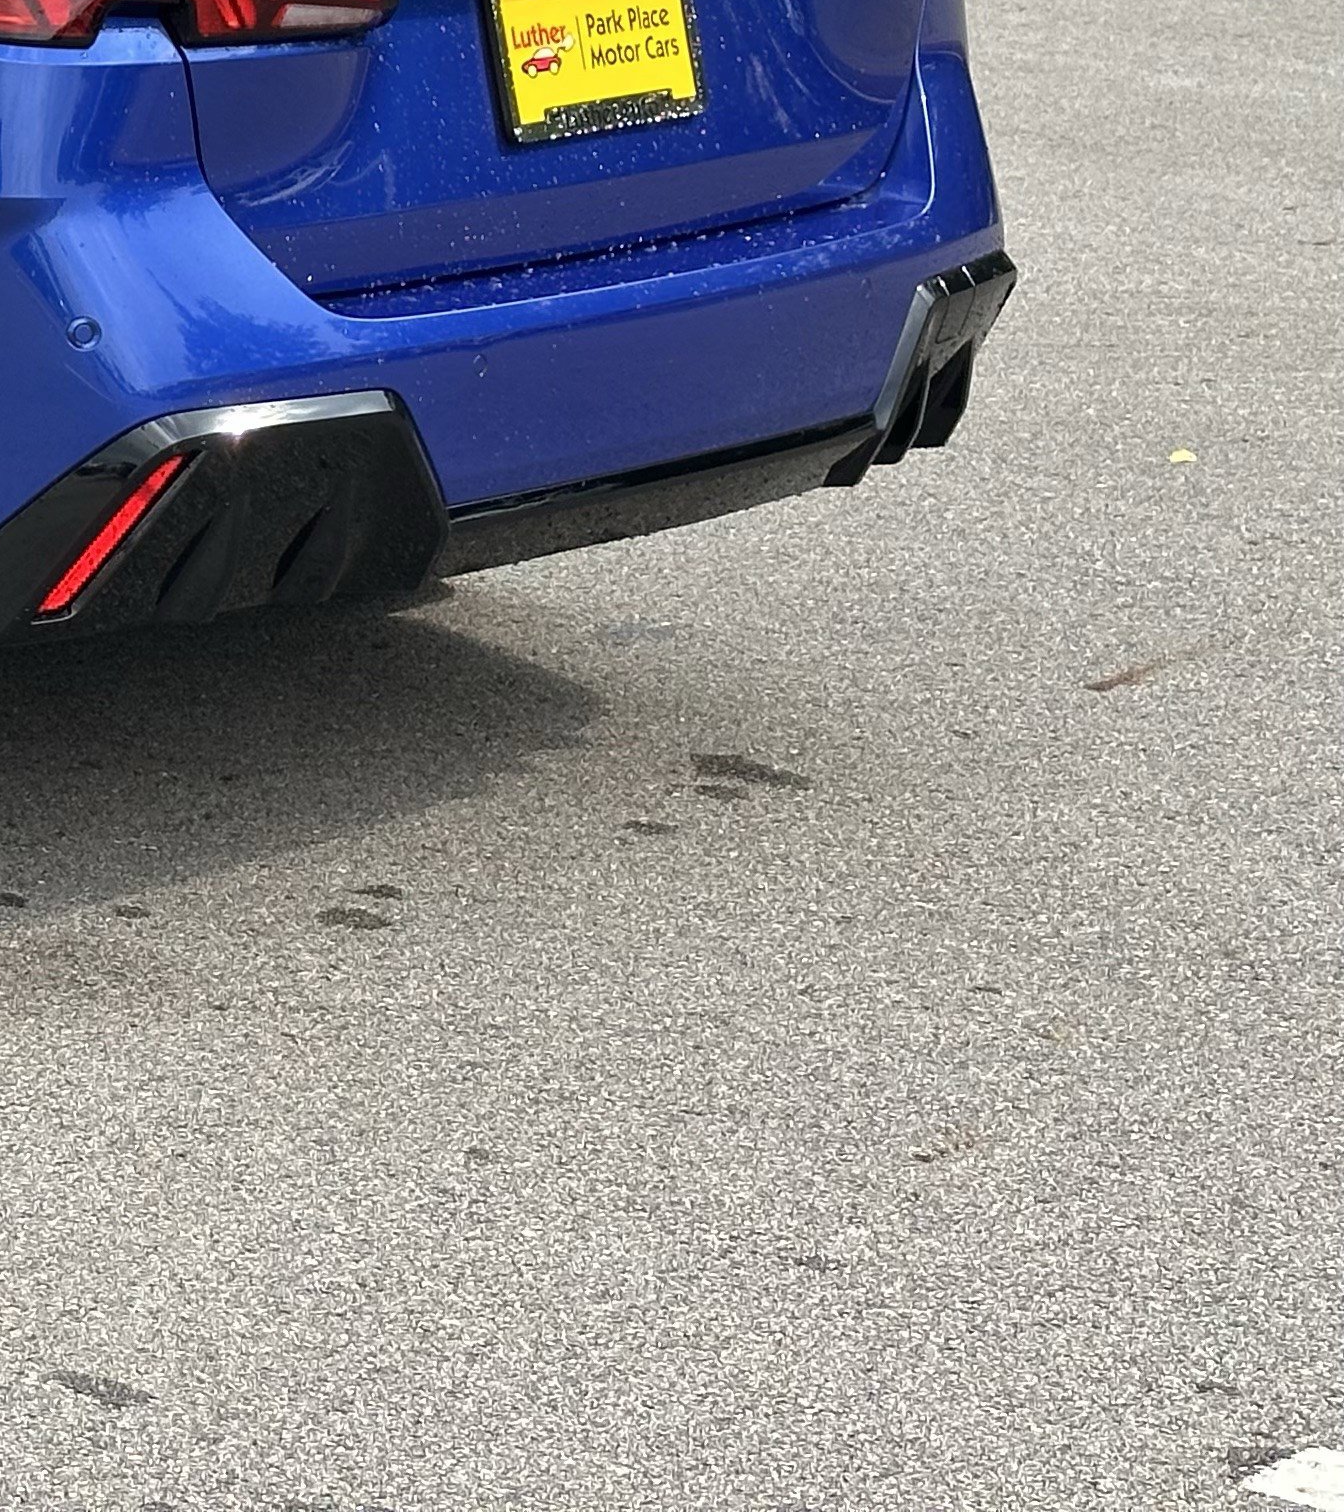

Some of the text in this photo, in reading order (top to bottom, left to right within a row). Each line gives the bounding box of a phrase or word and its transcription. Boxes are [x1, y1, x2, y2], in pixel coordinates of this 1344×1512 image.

[511, 22, 567, 50] Luther
[585, 5, 671, 38] Park Place
[590, 36, 681, 70] Motor Cars
